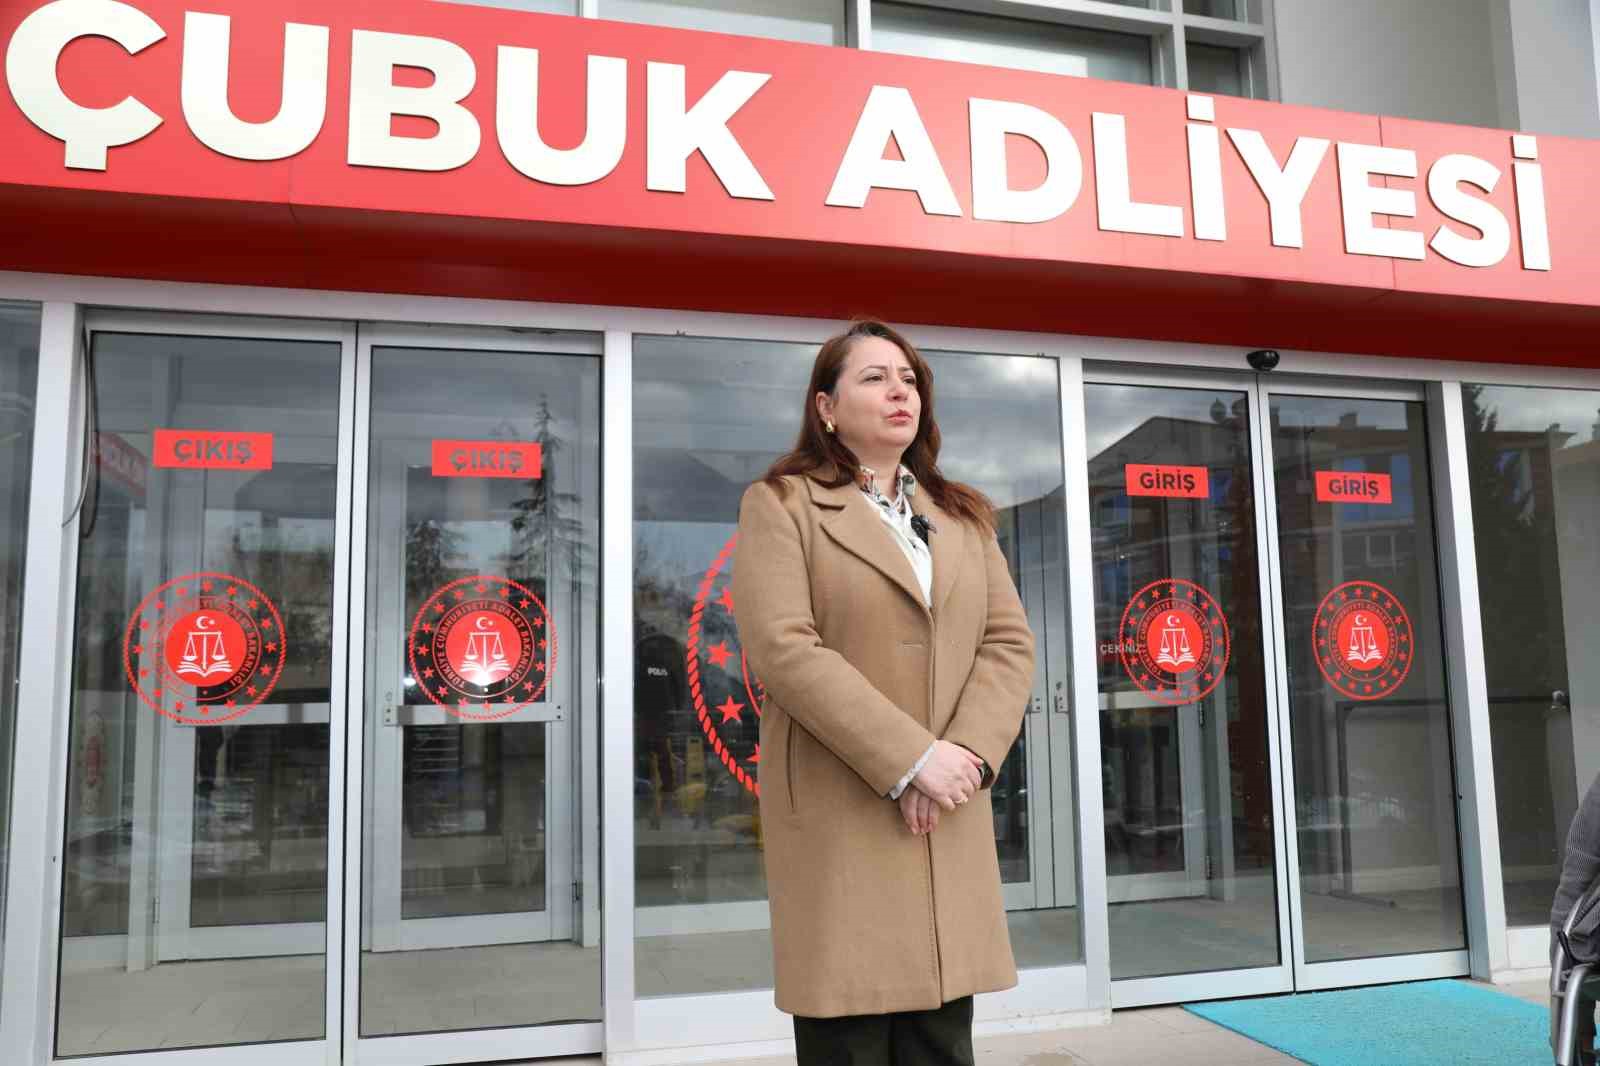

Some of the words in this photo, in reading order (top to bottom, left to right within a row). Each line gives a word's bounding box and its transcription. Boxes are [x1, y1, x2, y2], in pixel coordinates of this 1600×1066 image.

[5, 0, 776, 201] ÇUBUK
[824, 84, 1552, 272] ADLİYESİ
[174, 439, 252, 465] ÇIKIŞ
[449, 448, 524, 474] ÇIKIŞ
[1139, 468, 1196, 493] GİRİŞ
[1328, 475, 1379, 500] GİRİŞ
